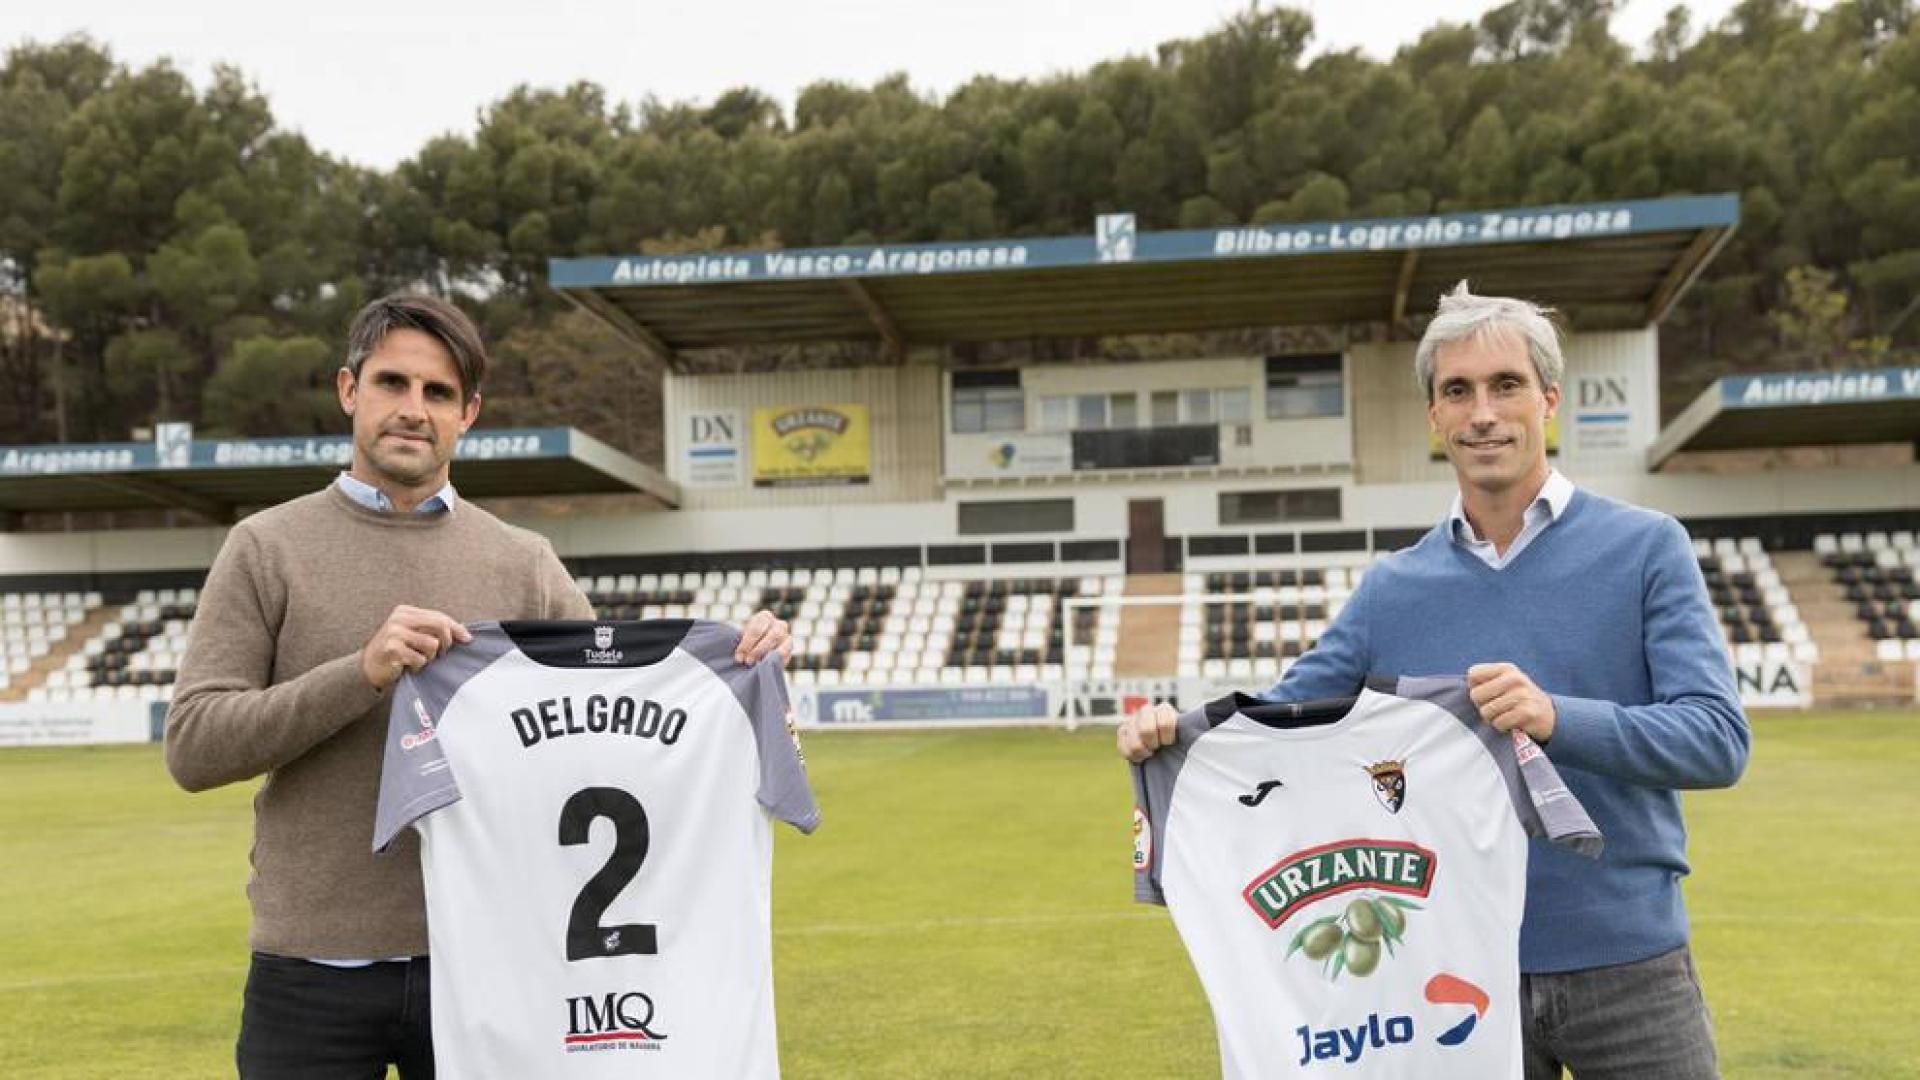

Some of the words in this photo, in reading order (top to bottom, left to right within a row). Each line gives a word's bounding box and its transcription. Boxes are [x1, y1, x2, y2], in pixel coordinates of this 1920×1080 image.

[1213, 208, 1633, 255] Bilbao-Logroño-Zaragoza
[612, 258, 750, 283] Autopista
[765, 244, 1029, 278] Vasco-Aragonesa
[1742, 373, 1888, 404] Autopista
[583, 647, 624, 660] Tudela
[510, 693, 688, 749] DELGADO
[558, 785, 658, 962] 2
[1258, 848, 1420, 911] URZANTE
[564, 991, 669, 1040] IMQ
[1295, 1011, 1415, 1068] Jaylo
